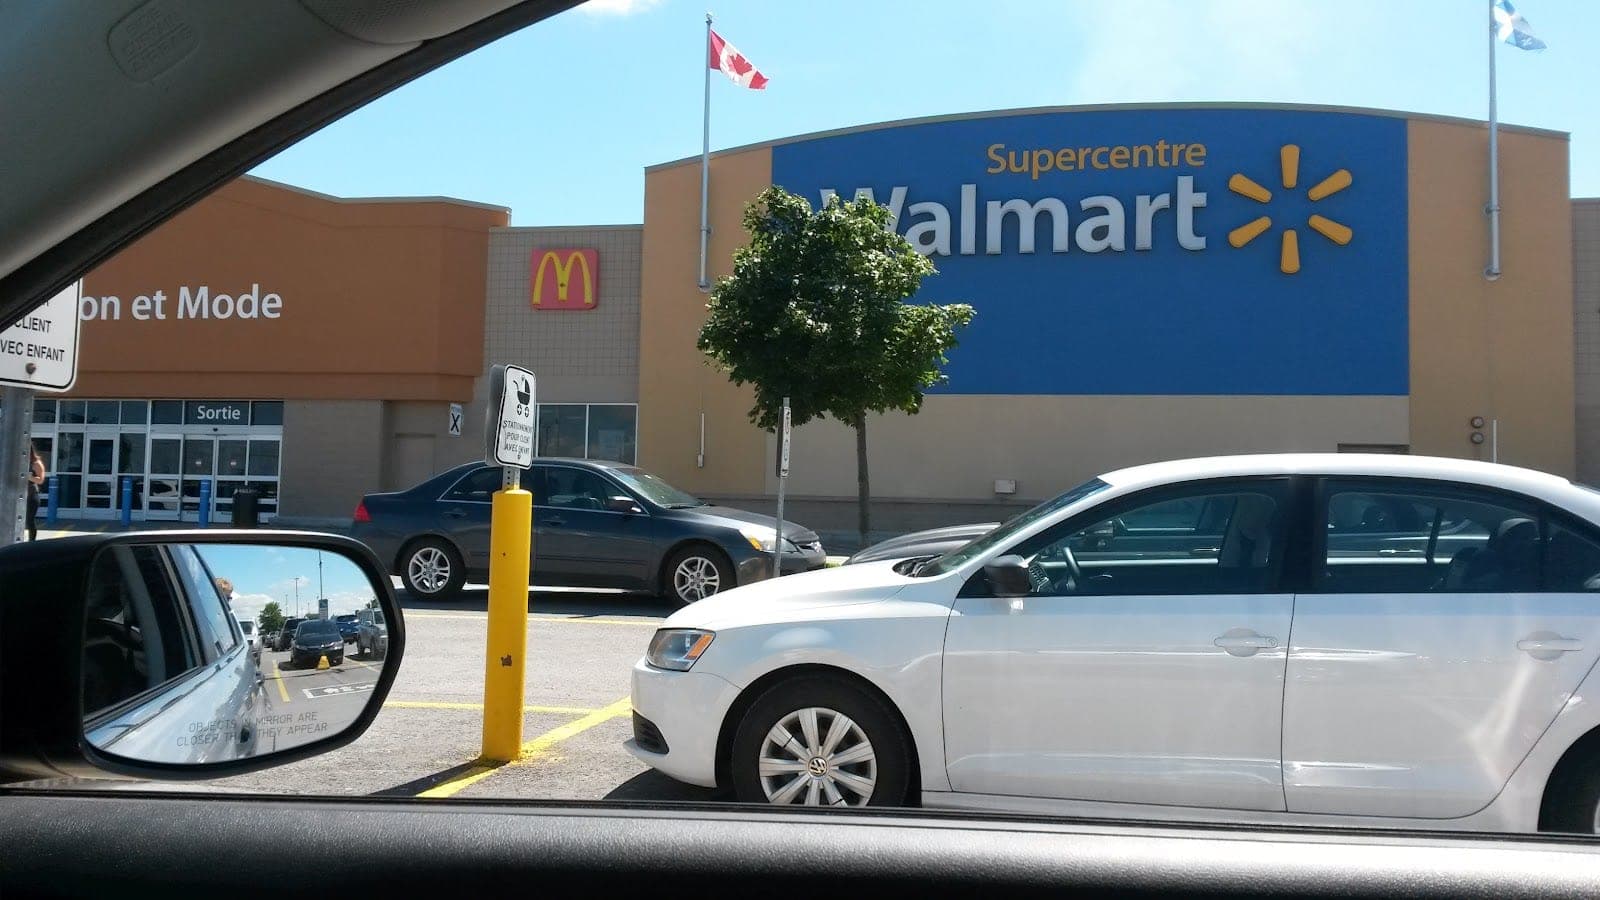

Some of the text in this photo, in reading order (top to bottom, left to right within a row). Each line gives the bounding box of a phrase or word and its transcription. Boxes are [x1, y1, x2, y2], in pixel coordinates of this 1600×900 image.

[986, 139, 1207, 180] Supercentre
[131, 290, 167, 320] et
[177, 283, 283, 319] Mode
[0, 340, 65, 362] VEC ENFANT
[197, 405, 241, 421] Sortie
[188, 719, 237, 733] OBJECTS
[255, 714, 293, 726] MIRROR
[298, 712, 319, 722] ARE
[176, 733, 219, 747] CLOSER
[257, 726, 282, 738] THEY
[287, 722, 329, 736] APPEAR
